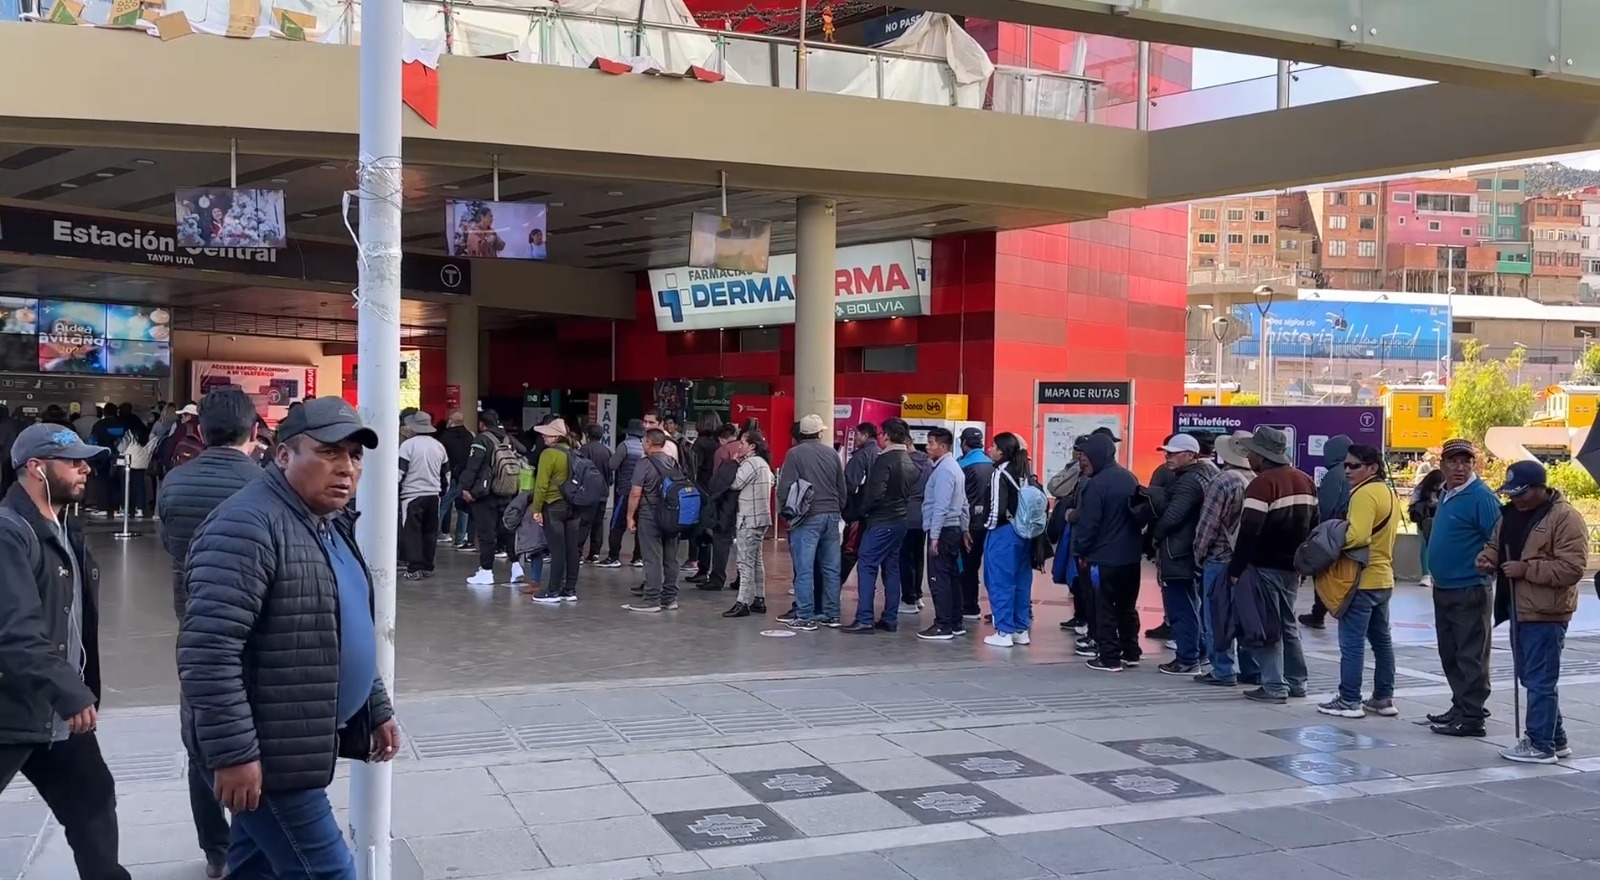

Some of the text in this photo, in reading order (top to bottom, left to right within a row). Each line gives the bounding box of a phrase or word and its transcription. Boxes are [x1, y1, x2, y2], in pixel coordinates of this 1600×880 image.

[885, 21, 898, 33] NO
[53, 220, 174, 251] Estación
[147, 253, 194, 265] TAYPI UTA
[847, 301, 905, 315] BOLIVIA
[1284, 318, 1305, 327] siglos
[1306, 319, 1316, 327] de
[1044, 388, 1120, 399] MAPA DE RUTAS
[1179, 417, 1241, 427] Mi Teleférico
